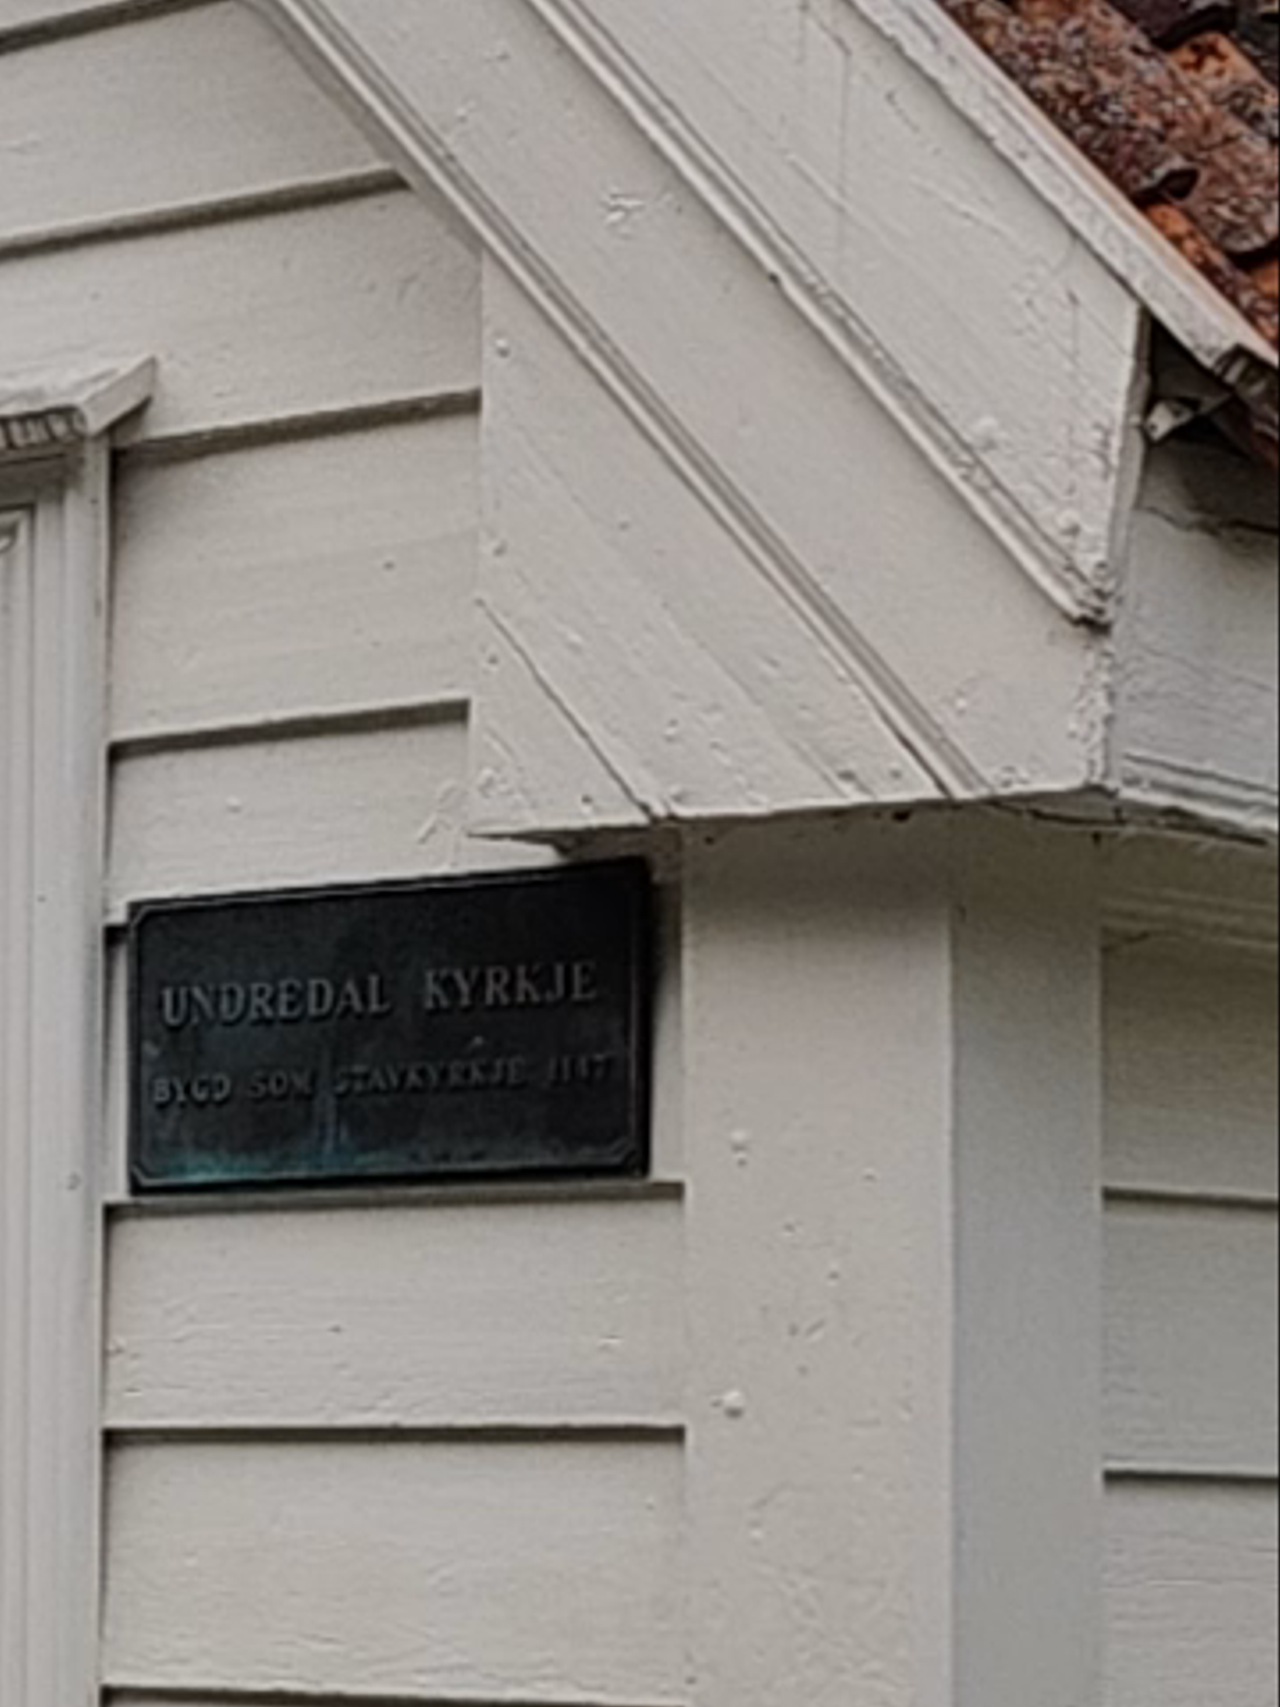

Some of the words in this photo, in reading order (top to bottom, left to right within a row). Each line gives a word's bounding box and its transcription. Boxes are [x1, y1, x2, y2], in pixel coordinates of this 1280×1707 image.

[160, 974, 391, 1028] UNDREDAL
[423, 960, 597, 1011] KYRKJE
[152, 1071, 231, 1106] BYGD
